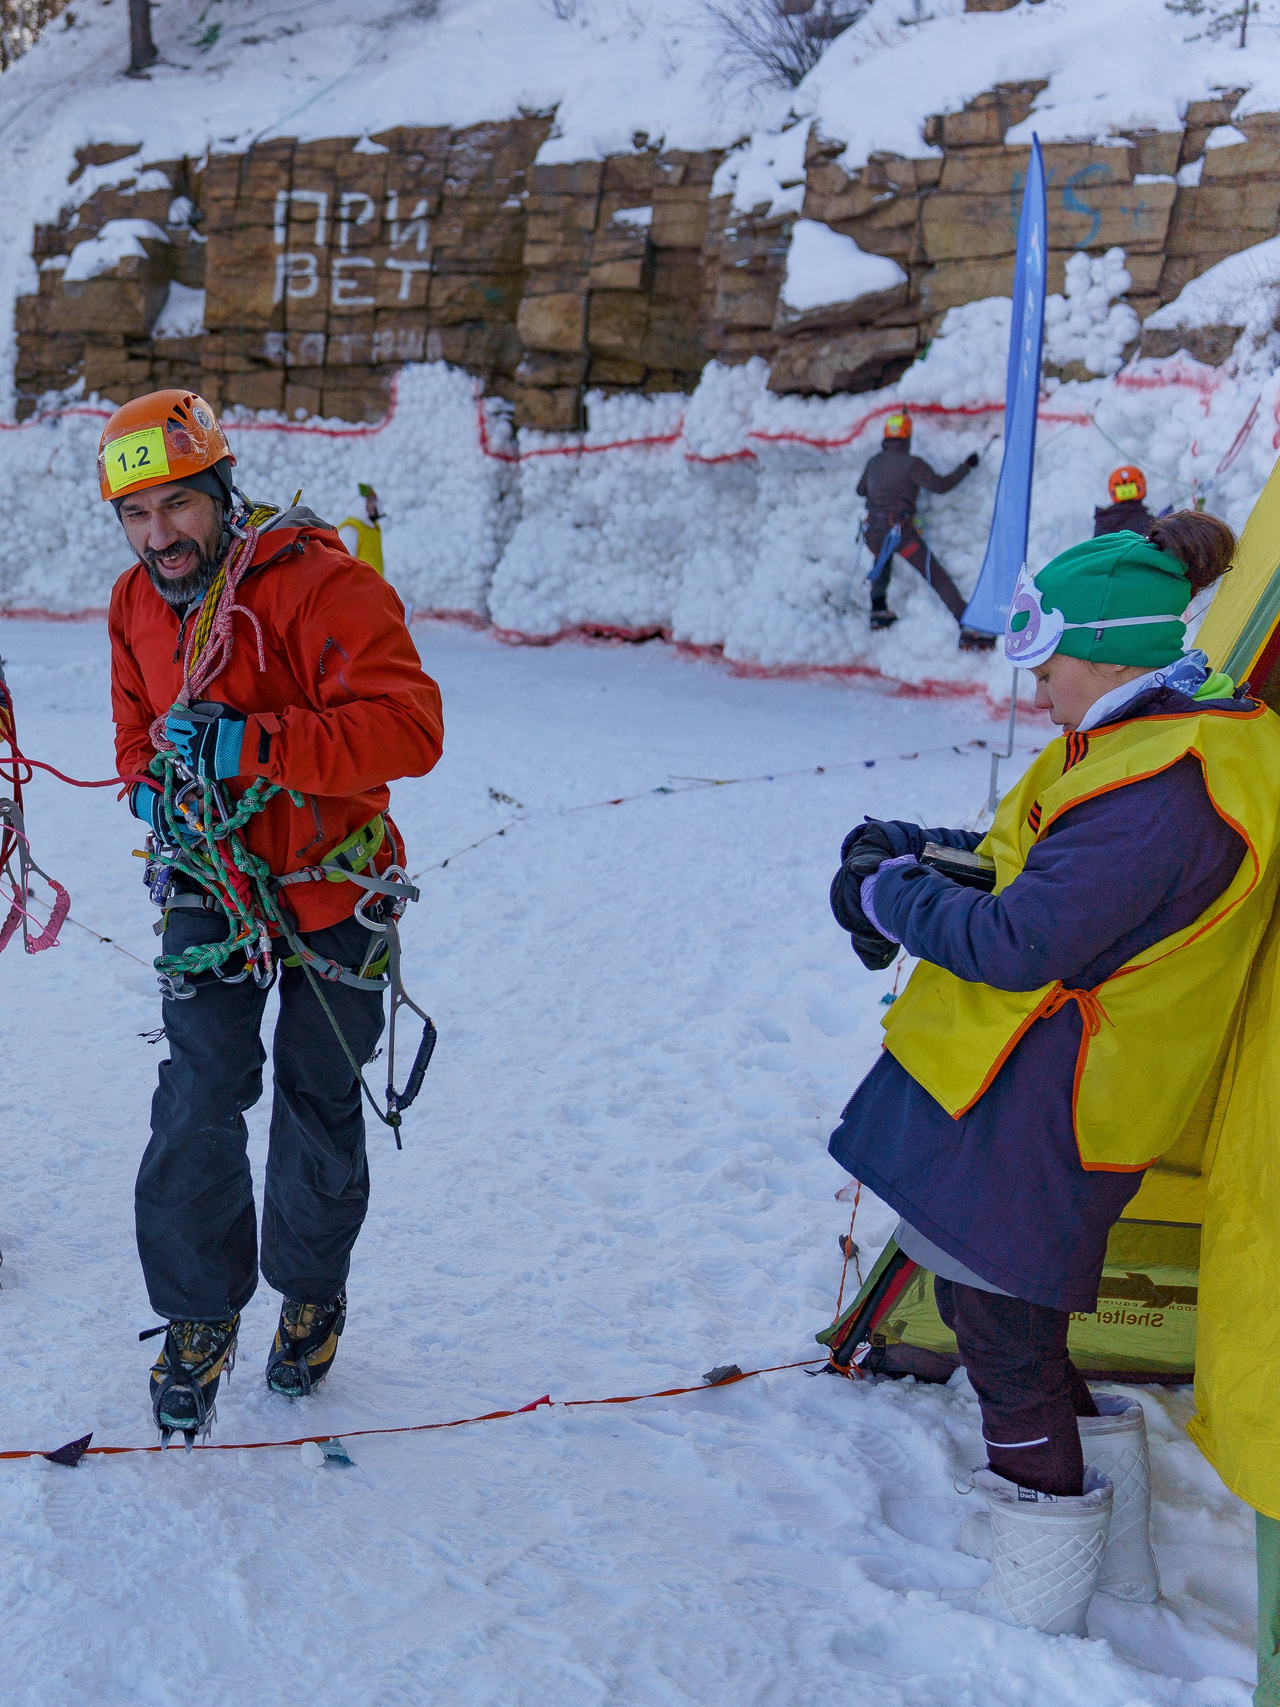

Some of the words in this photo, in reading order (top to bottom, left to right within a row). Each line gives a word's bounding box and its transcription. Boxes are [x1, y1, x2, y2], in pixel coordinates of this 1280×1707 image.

[274, 189, 430, 254] ПРИ
[273, 252, 431, 305] ВЕТ
[117, 445, 151, 472] 1.2
